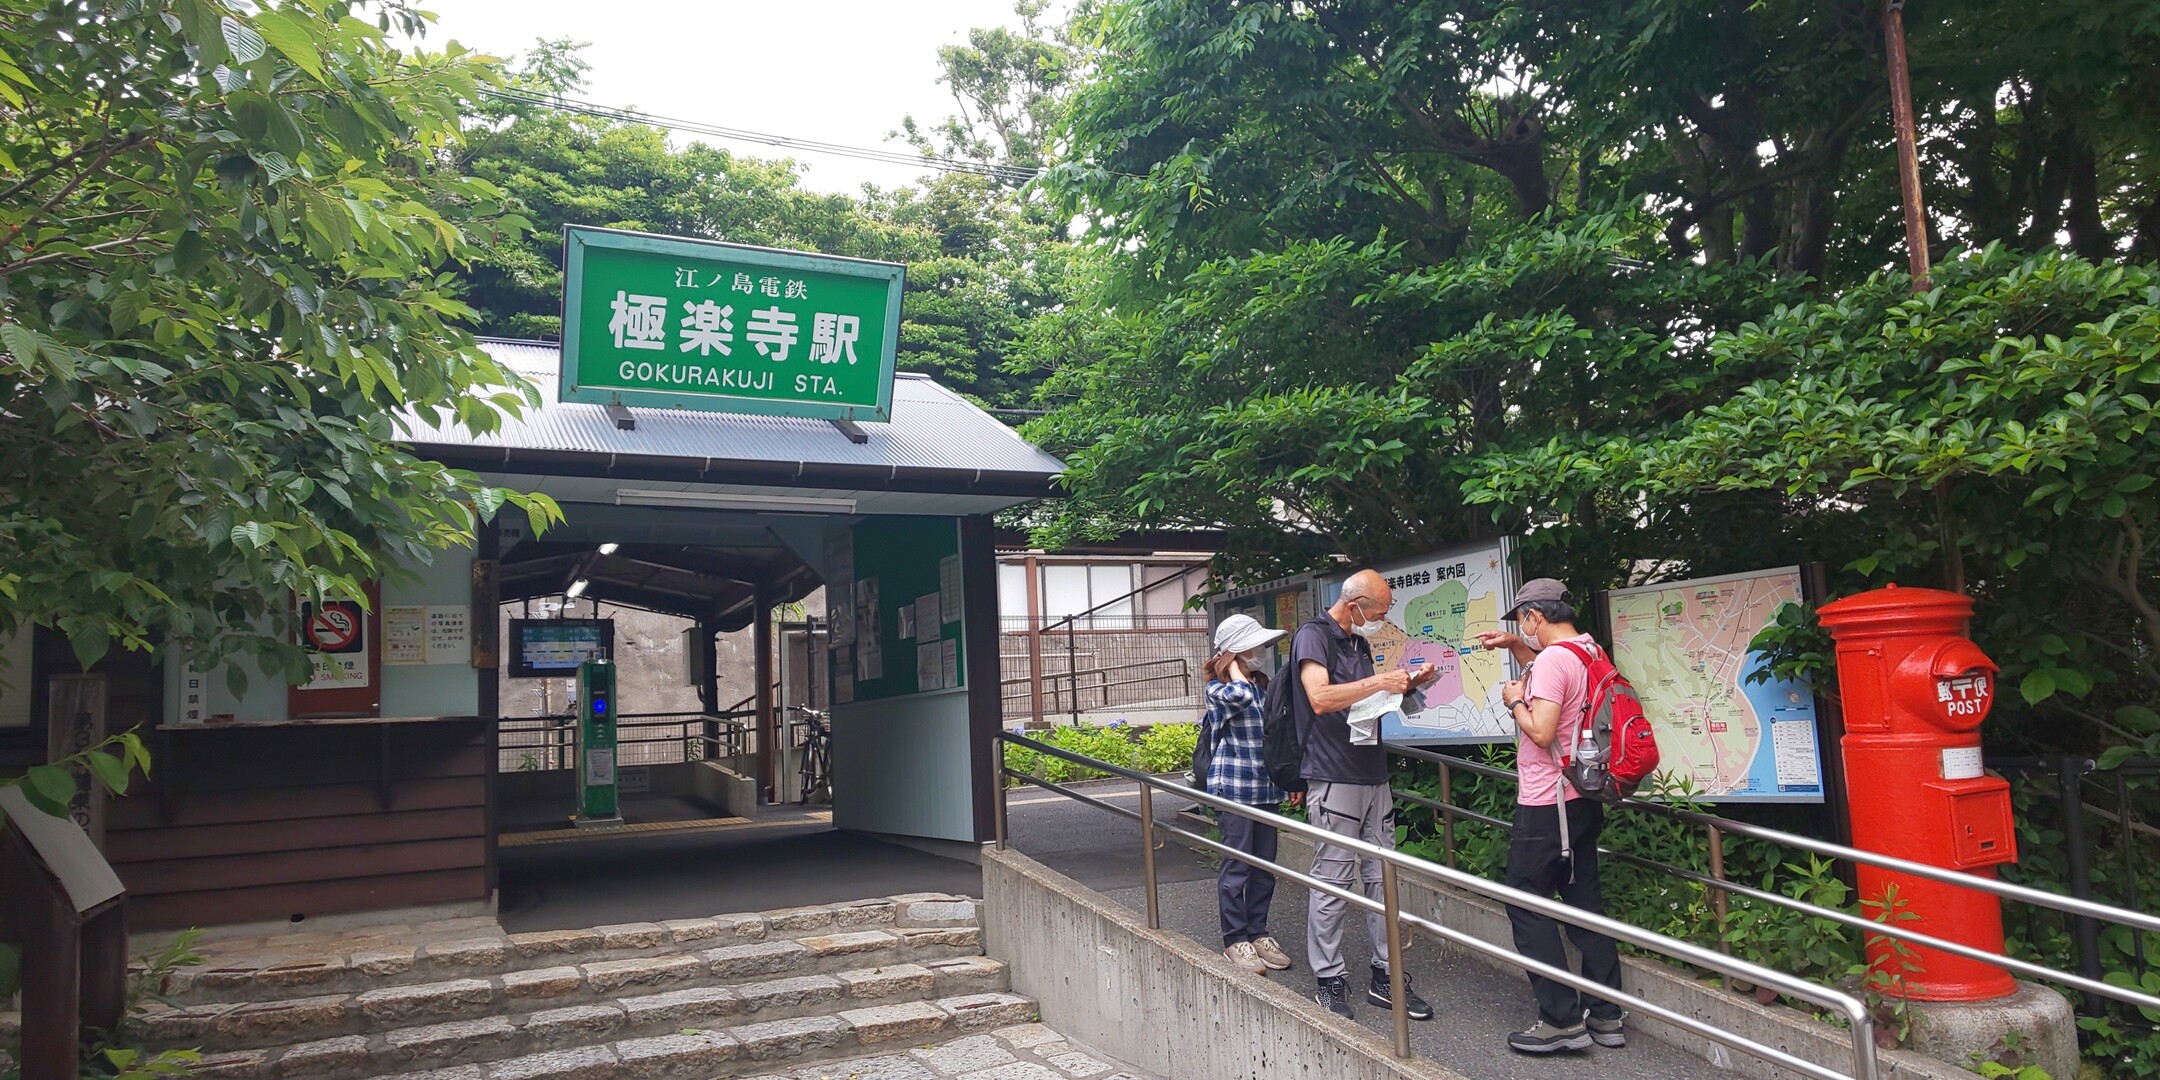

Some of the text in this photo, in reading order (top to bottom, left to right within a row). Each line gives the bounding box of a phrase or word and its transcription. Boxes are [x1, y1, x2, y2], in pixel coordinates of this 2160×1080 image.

[674, 266, 808, 300] 江ノ島電鉄
[608, 290, 860, 365] 極楽寺駅
[619, 360, 844, 396] GOKURAKUJI STA.
[1384, 562, 1466, 590] 楽寺自栄会 案内図
[331, 671, 363, 681] SMING
[1947, 698, 1982, 717] POST
